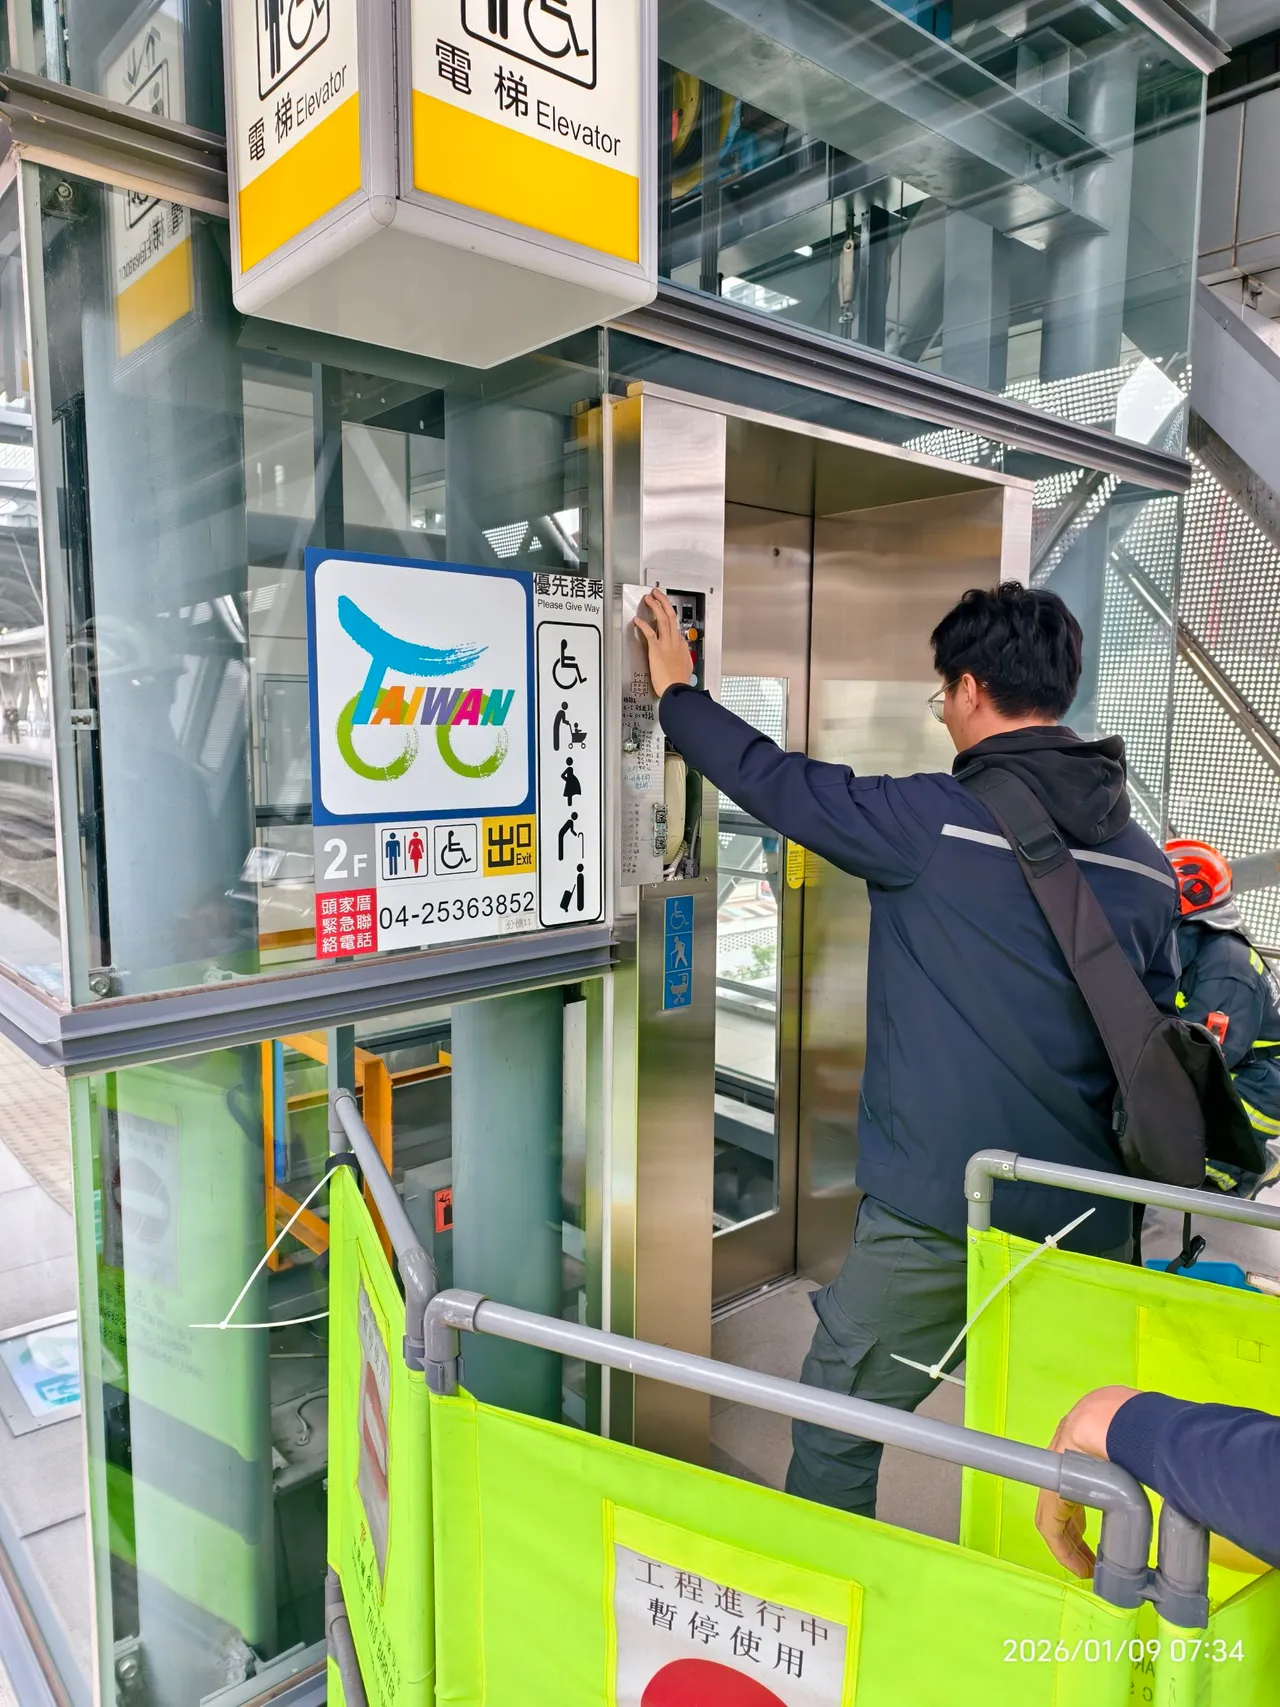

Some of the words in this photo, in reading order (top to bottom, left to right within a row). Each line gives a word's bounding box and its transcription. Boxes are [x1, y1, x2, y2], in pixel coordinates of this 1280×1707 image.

[248, 92, 293, 161] 電梯
[296, 64, 347, 127] Elevator
[435, 38, 529, 118] 電梯
[536, 99, 621, 156] Elevator
[533, 573, 604, 600] 優先搭乘
[537, 599, 563, 610] Please
[565, 601, 582, 612] Give
[584, 603, 600, 615] Way
[338, 594, 516, 727] TAIWAN
[323, 838, 368, 880] 2F
[487, 823, 532, 868] 出口
[516, 852, 532, 866] Exit
[322, 913, 372, 935] 緊急聯
[379, 891, 535, 930] 04-25363852
[505, 918, 532, 931] 分機11
[322, 932, 373, 953] 絡電話
[634, 1557, 829, 1647] 工程進行中
[646, 1596, 805, 1679] 暫停使用
